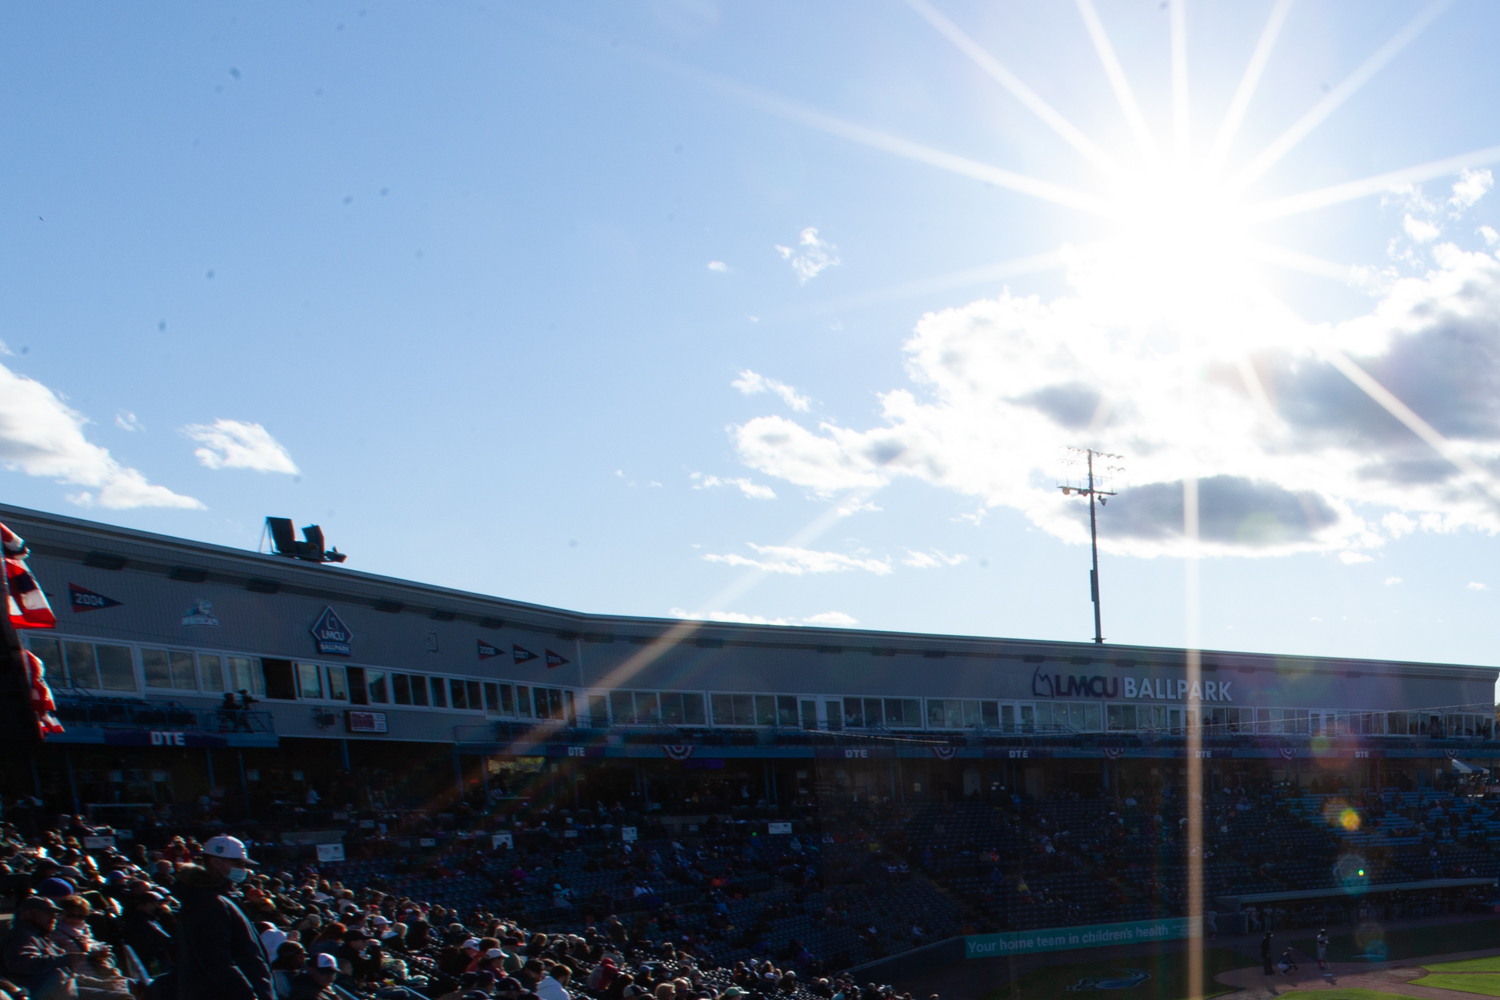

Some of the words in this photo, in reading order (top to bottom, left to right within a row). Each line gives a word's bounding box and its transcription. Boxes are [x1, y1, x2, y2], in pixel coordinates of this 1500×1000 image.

[75, 593, 104, 606] 2004
[321, 629, 345, 641] LMCU
[1056, 674, 1118, 698] LMCU
[1124, 677, 1233, 702] BALLPARK
[151, 731, 186, 746] DTE
[567, 746, 586, 757] DTE
[845, 749, 868, 758] DTE
[1009, 750, 1029, 758] DTE
[1195, 750, 1212, 758] DTE
[968, 940, 997, 954] Your
[999, 937, 1034, 951] home
[1037, 933, 1067, 947] team
[1068, 932, 1079, 945] in
[1081, 928, 1134, 944] children's
[1135, 924, 1170, 938] health
